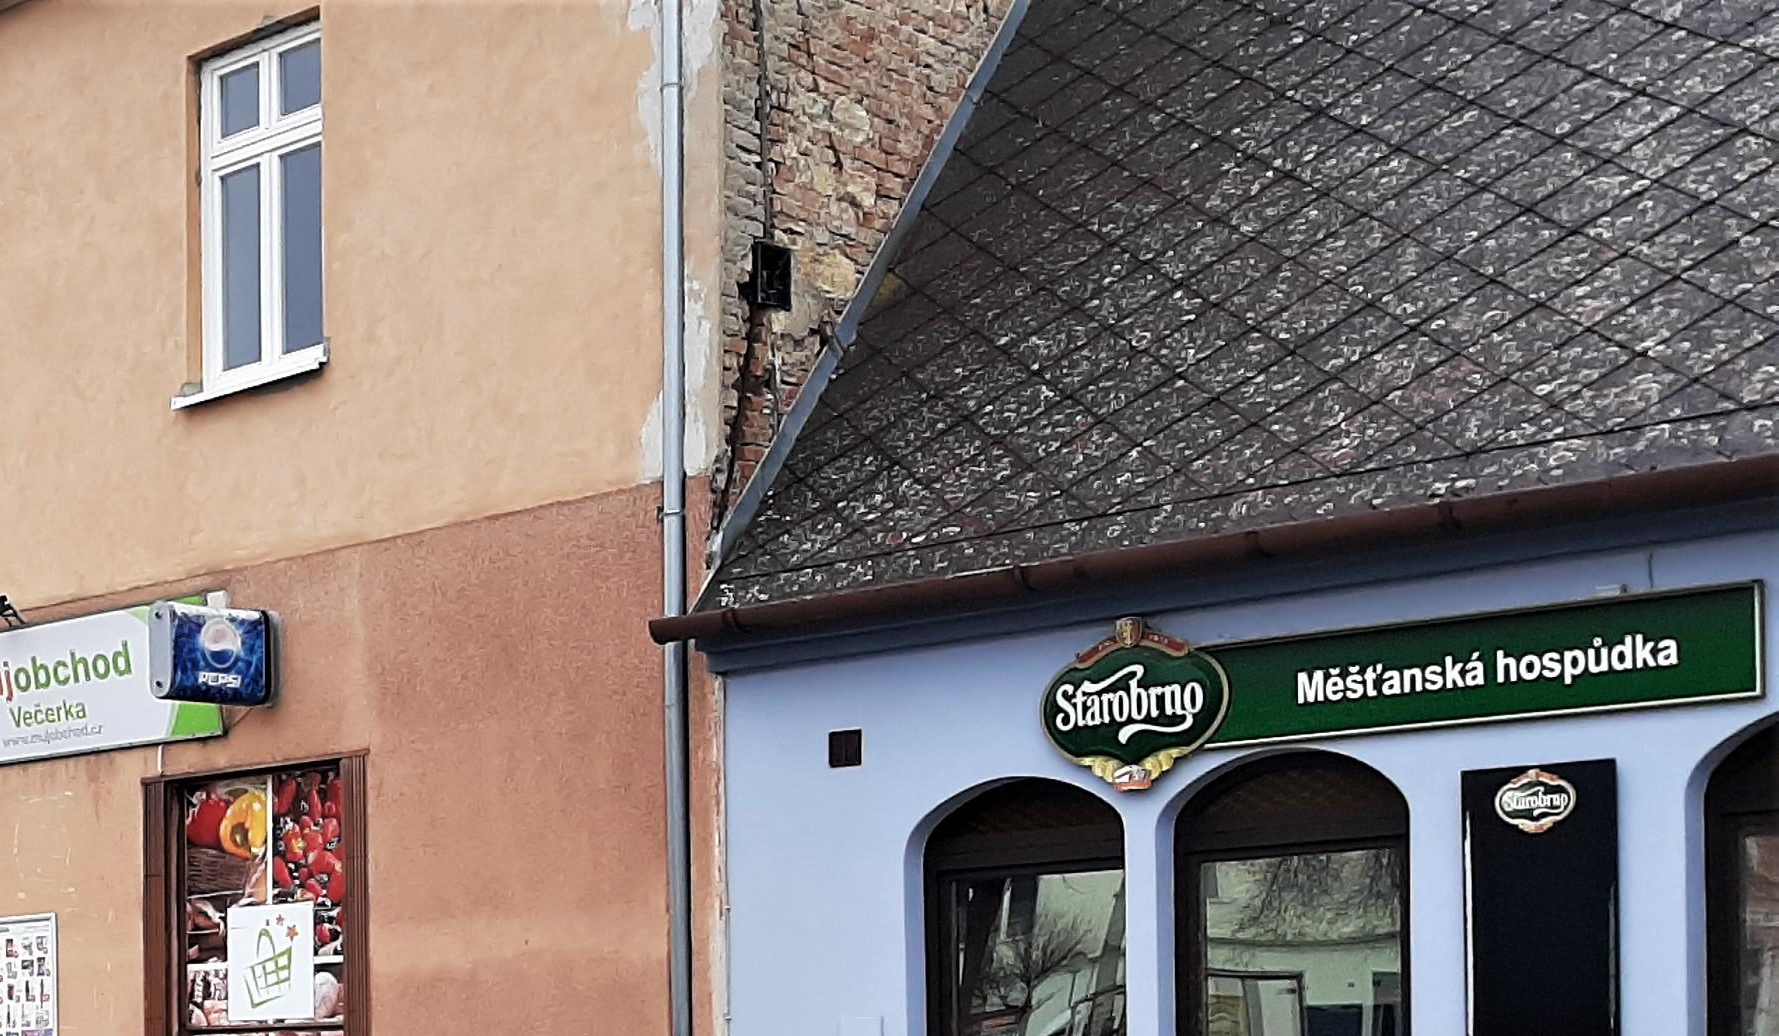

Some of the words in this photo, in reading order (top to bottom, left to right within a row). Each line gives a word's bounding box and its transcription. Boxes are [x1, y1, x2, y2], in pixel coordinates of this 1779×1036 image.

[1055, 664, 1204, 745] Starobrno
[1296, 651, 1485, 705] Měšťanská
[1496, 633, 1679, 685] hospůdka
[9, 699, 87, 728] Večerka
